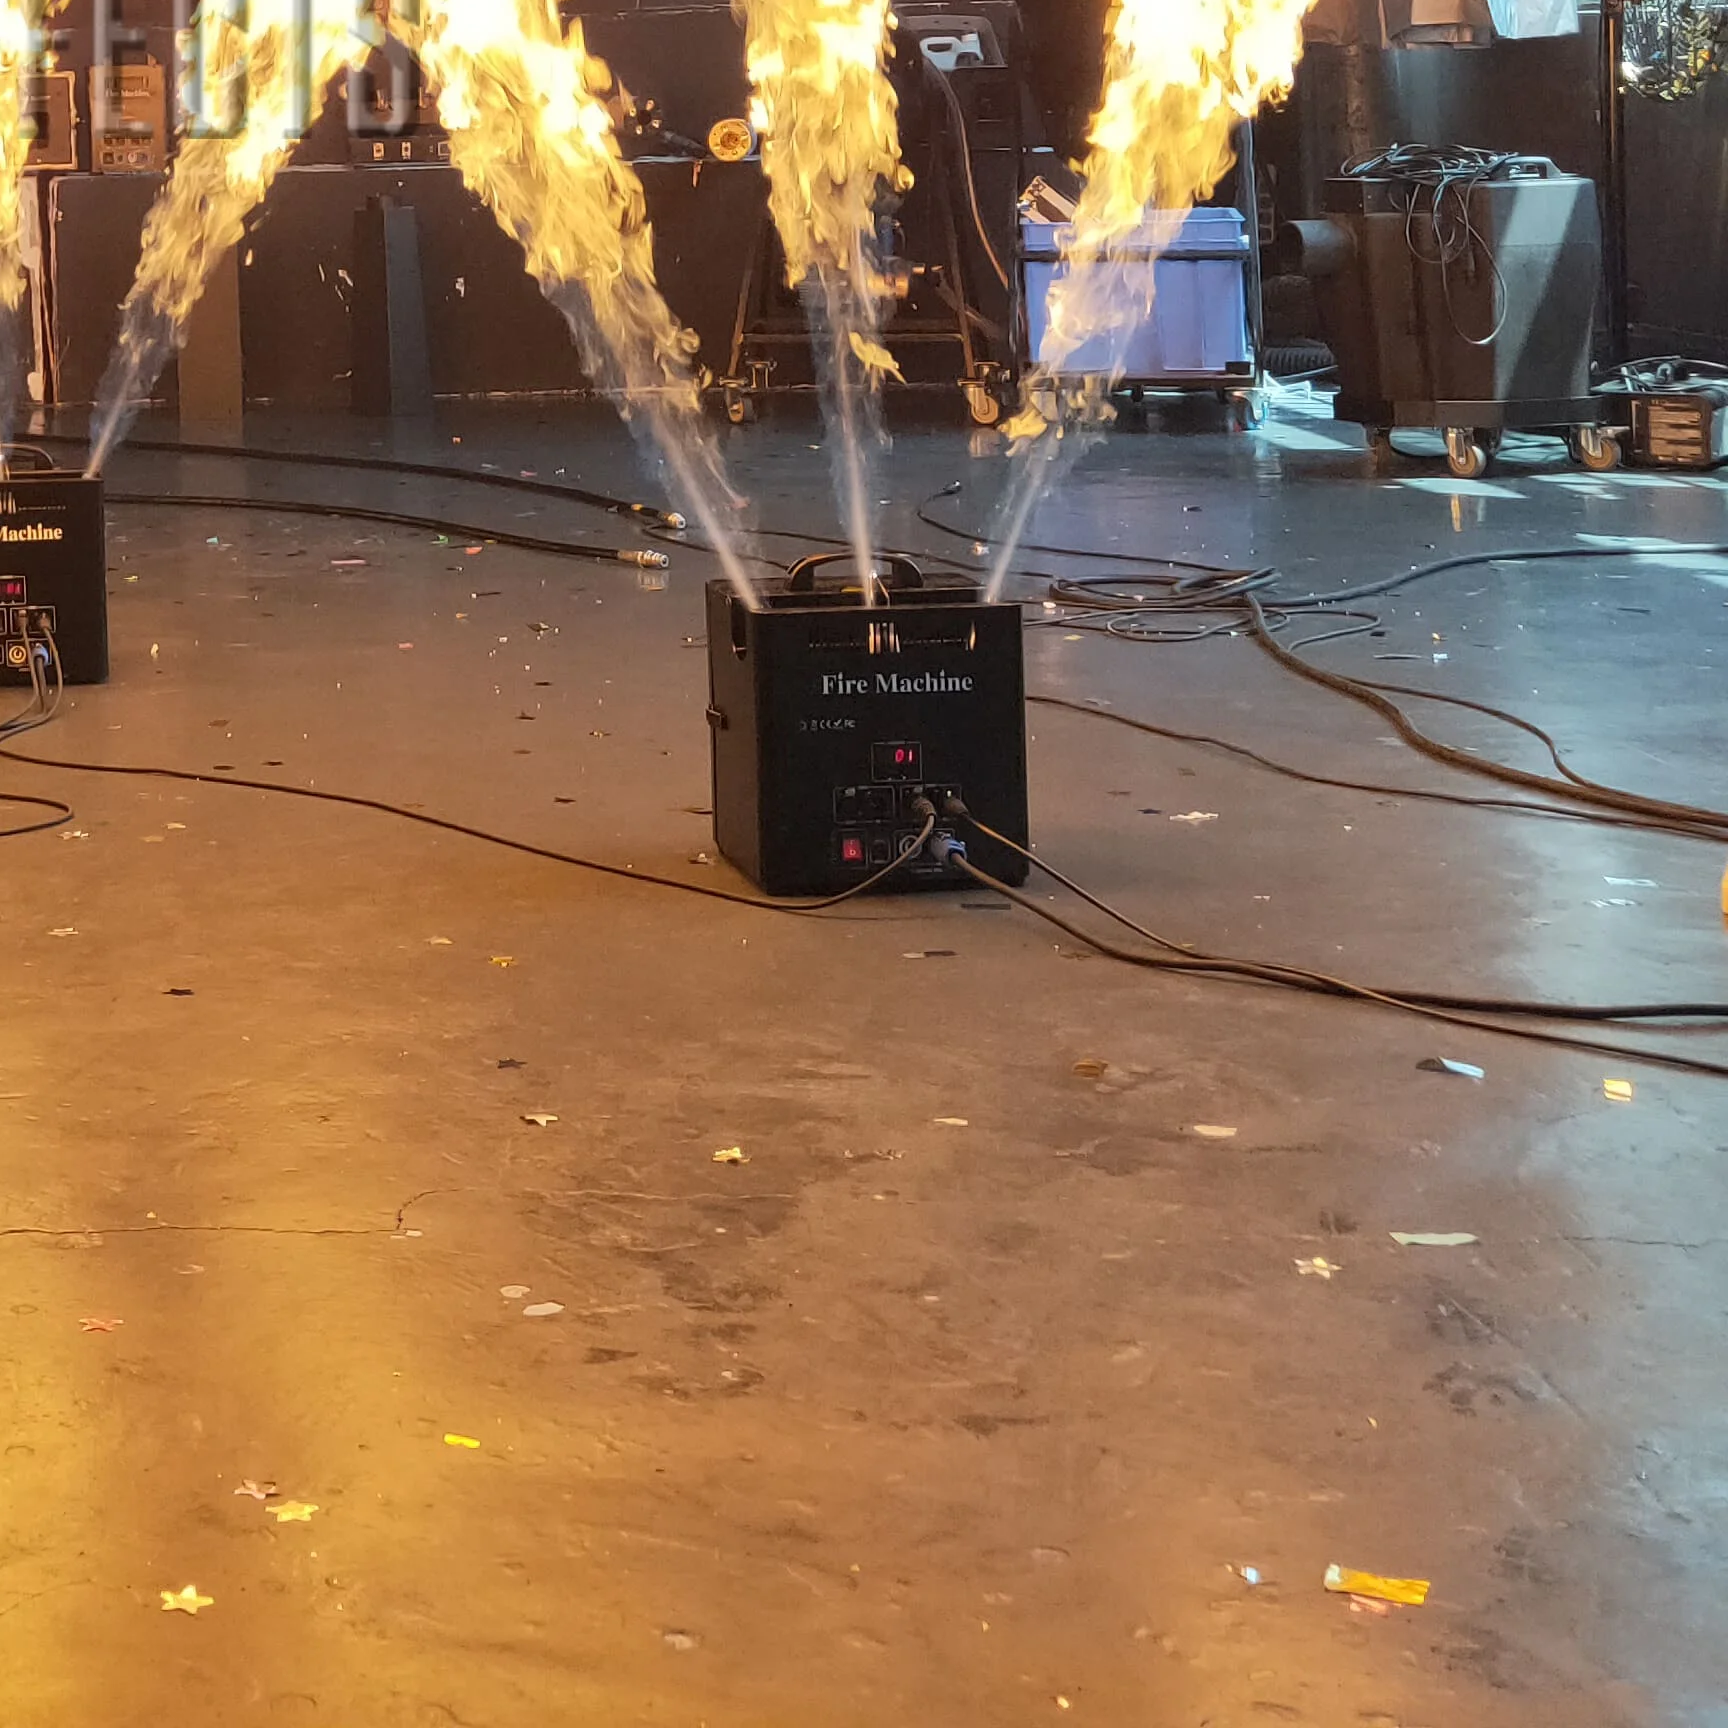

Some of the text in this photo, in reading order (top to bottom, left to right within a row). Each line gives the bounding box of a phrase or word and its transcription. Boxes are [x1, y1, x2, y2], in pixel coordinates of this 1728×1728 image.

[821, 668, 974, 696] Fire Machine
[895, 748, 914, 763] 01
